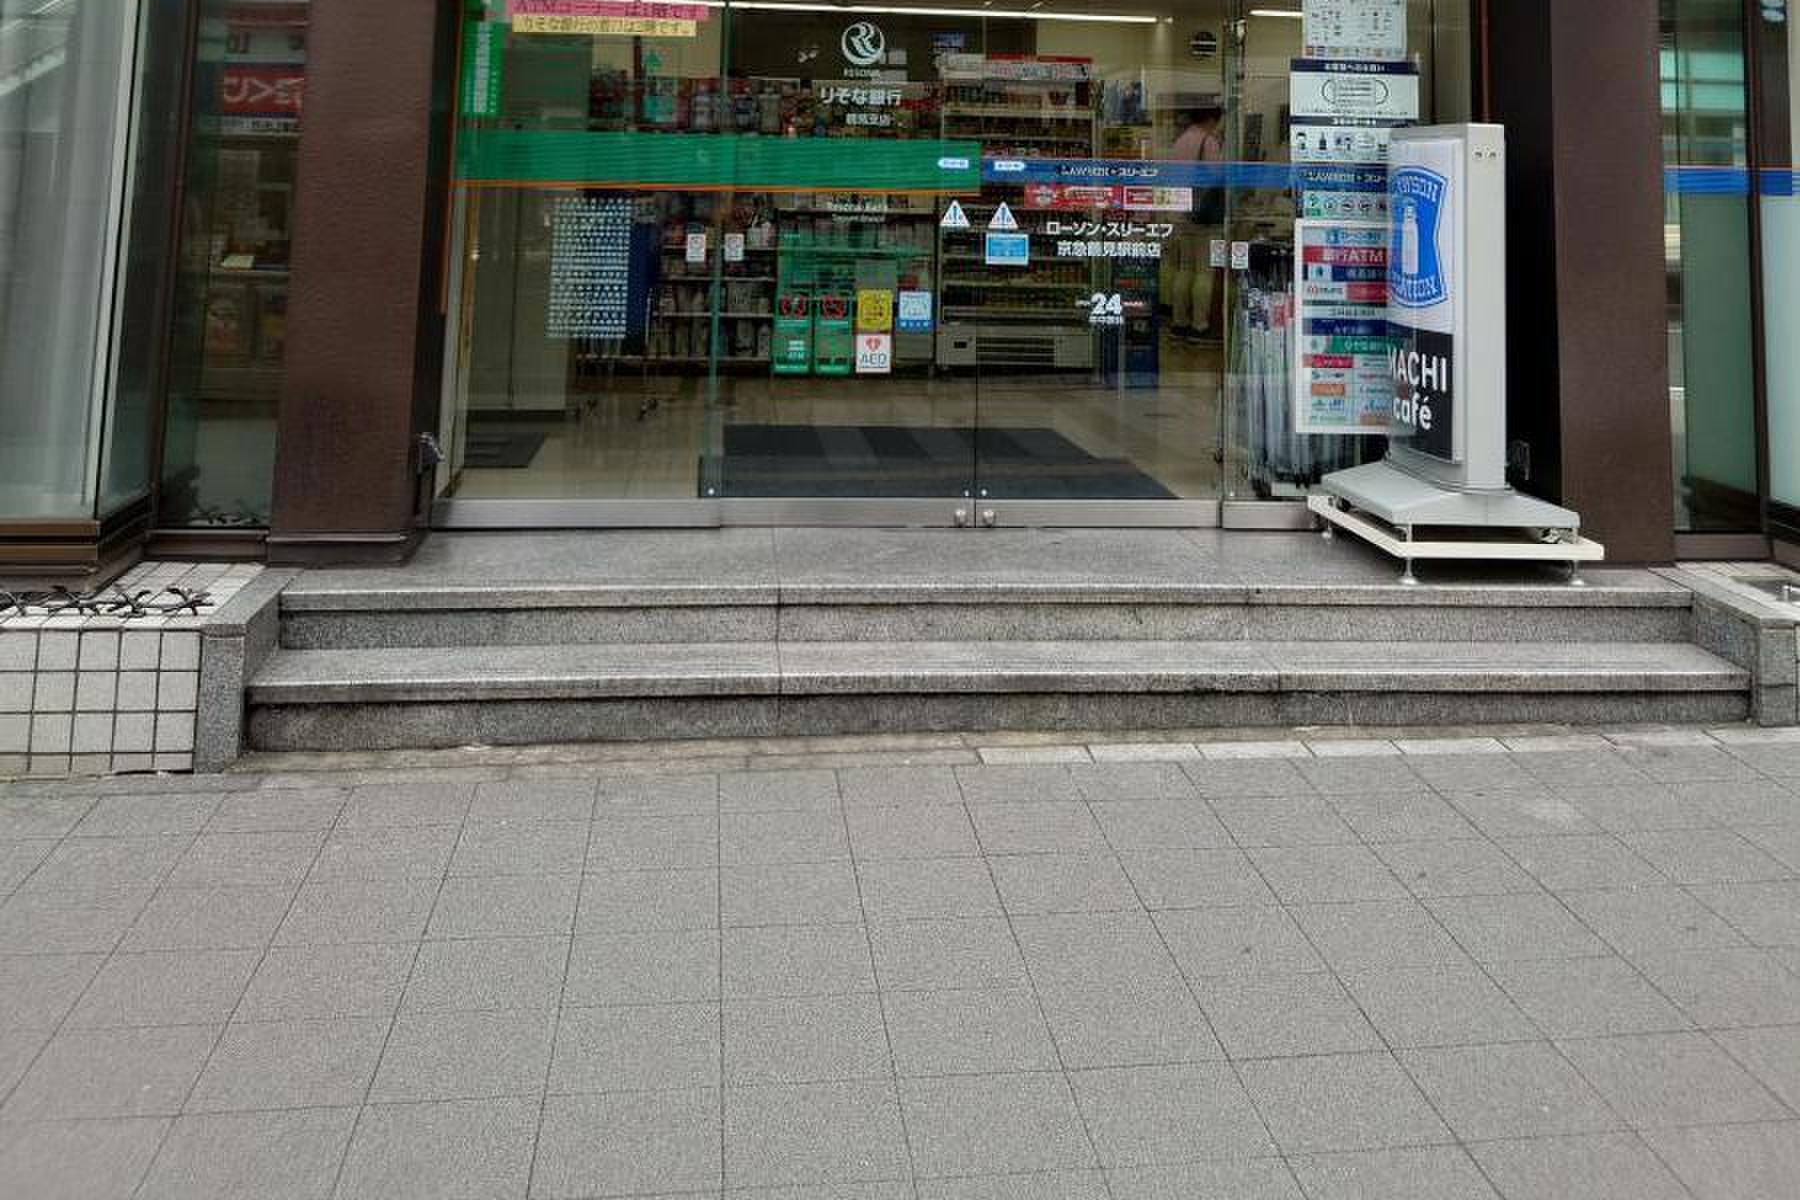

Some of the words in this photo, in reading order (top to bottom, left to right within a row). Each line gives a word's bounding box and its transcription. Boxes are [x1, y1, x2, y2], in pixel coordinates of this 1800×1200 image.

[820, 86, 903, 106] りそな銀行
[1046, 221, 1174, 238] ローソン・スリーエフ
[1090, 293, 1123, 314] 24
[862, 352, 887, 365] AED
[1393, 392, 1432, 430] café
